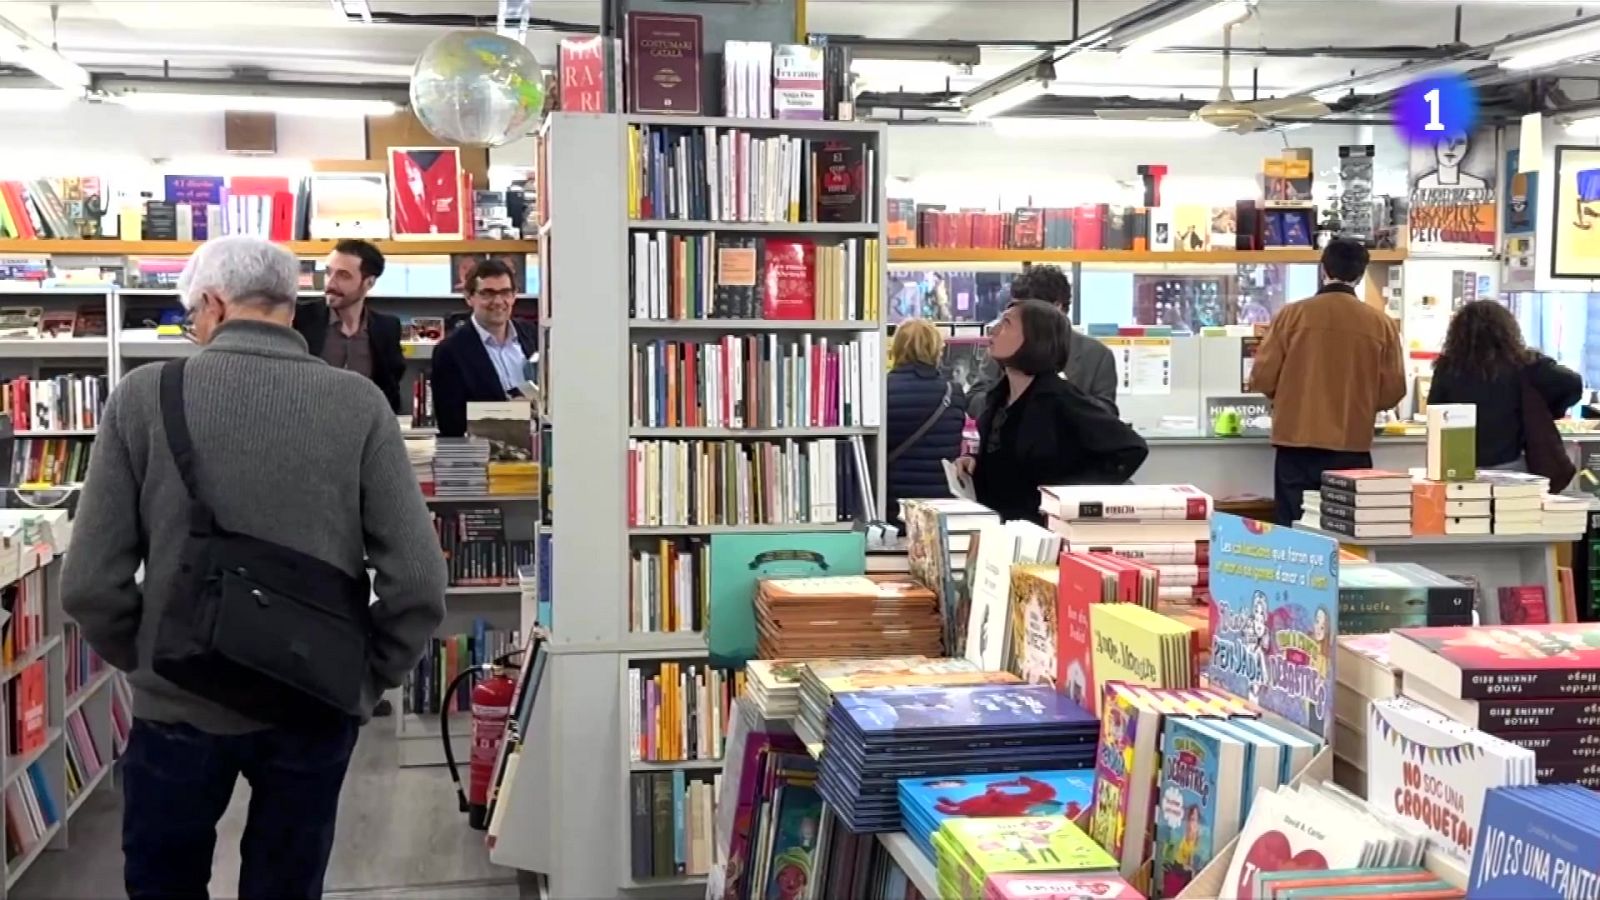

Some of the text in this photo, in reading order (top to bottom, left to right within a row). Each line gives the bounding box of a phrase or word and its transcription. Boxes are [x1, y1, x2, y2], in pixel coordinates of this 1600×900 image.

[1471, 674, 1539, 684] JENKINS REID
[1486, 685, 1523, 694] TAYLOR
[1489, 707, 1555, 716] JENKINS REID
[1504, 717, 1540, 726] TAYLOR
[1403, 761, 1464, 814] NO SOC UNA
[1394, 787, 1473, 855] CROQUETA!
[1477, 824, 1506, 889] NO
[1503, 834, 1523, 875] ES
[1523, 843, 1551, 885] UNA
